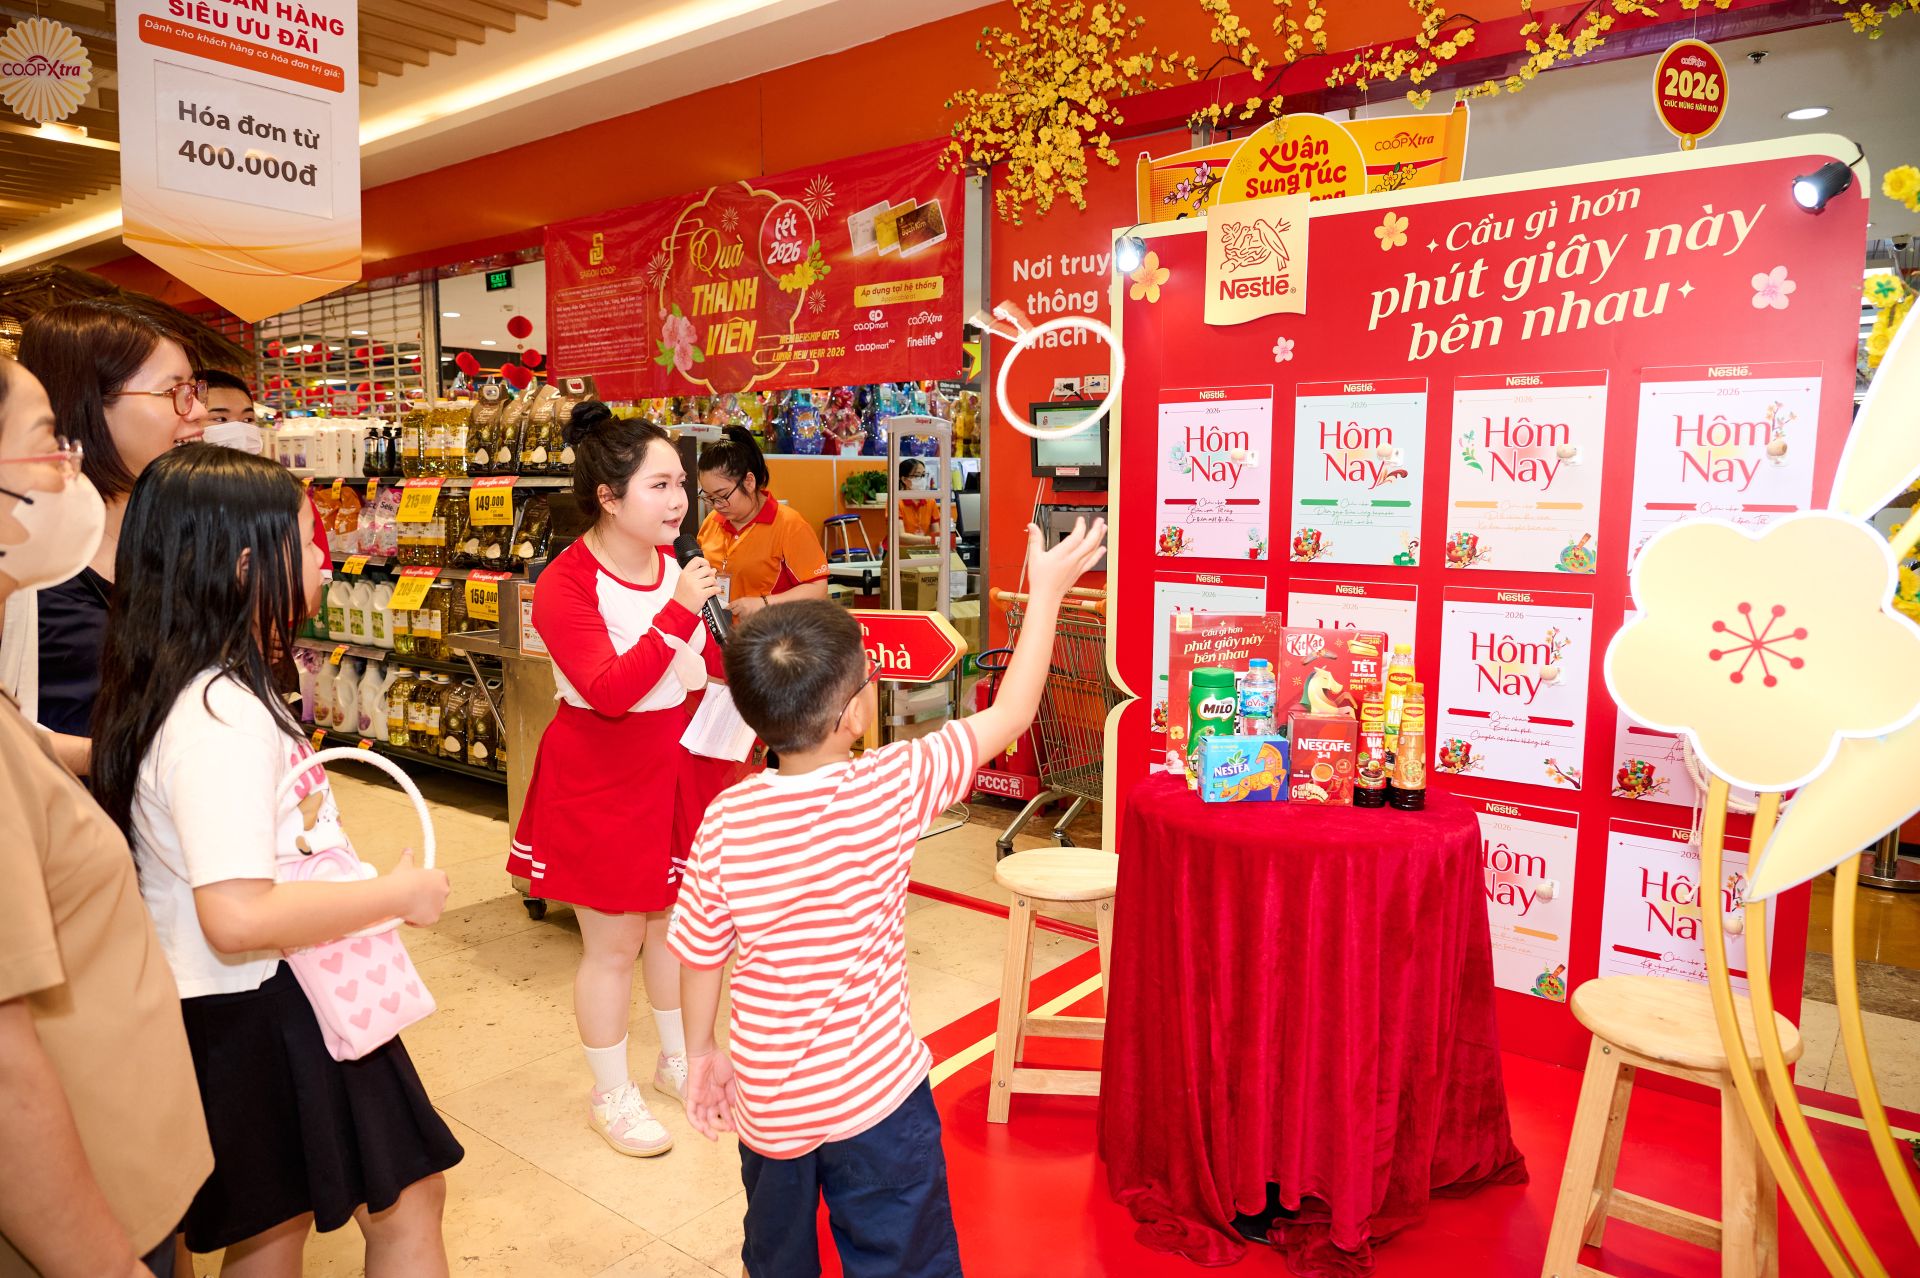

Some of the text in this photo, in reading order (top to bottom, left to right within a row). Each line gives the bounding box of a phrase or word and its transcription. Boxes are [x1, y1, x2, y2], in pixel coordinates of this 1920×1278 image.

[168, 0, 318, 54] SIÊU ƯU ĐÃI
[276, 2, 344, 36] HÀNG
[144, 20, 340, 78] Dành cho khách hàng có hóa đơn trị giá:
[1665, 68, 1719, 101] 2026
[179, 100, 320, 150] Hóa đơn từ
[179, 140, 317, 187] 400.000đ
[1446, 188, 1642, 251] Cầu gì hơn
[690, 227, 744, 277] Quà
[767, 240, 802, 265] 2026
[1013, 252, 1110, 282] Nơi truy
[1368, 203, 1766, 331] phút giây này
[490, 273, 507, 281] EXIT
[861, 287, 871, 298] Áp
[872, 285, 890, 296] dụng
[892, 284, 903, 292] tại
[915, 280, 937, 290] thống
[1220, 274, 1289, 300] Nestlé
[691, 274, 759, 317] THÀNH
[1027, 288, 1098, 315] thông
[706, 317, 757, 357] VIÊN
[821, 329, 840, 340] GIFTS
[1408, 282, 1671, 362] bên nhau
[794, 349, 809, 360] NEW
[809, 347, 825, 359] YEAR
[827, 346, 845, 358] 2026
[1717, 388, 1740, 396] 2026
[1184, 425, 1249, 452] Hôm
[1319, 420, 1393, 450] Hôm
[1482, 416, 1569, 447] Hôm
[1673, 414, 1771, 447] Hôm
[1189, 455, 1242, 490] Nay
[1323, 452, 1385, 490] Nay
[1488, 451, 1561, 491] Nay
[1679, 450, 1761, 493] Nay
[475, 495, 505, 511] 149.000
[470, 588, 498, 605] 159.000
[1228, 626, 1243, 634] hơn
[1505, 611, 1524, 619] 2026
[1184, 633, 1264, 655] phút giây này
[1193, 650, 1248, 664] bên nhau
[1291, 634, 1322, 656] KitKat
[1469, 632, 1551, 665] Hôm
[1352, 659, 1377, 673] TẾT
[1475, 664, 1542, 705] Nay
[1203, 703, 1233, 714] MILO
[977, 774, 1008, 792] PCCC
[1214, 763, 1250, 778] NESTEA
[1009, 788, 1020, 797] 114
[1645, 900, 1702, 941] Na
